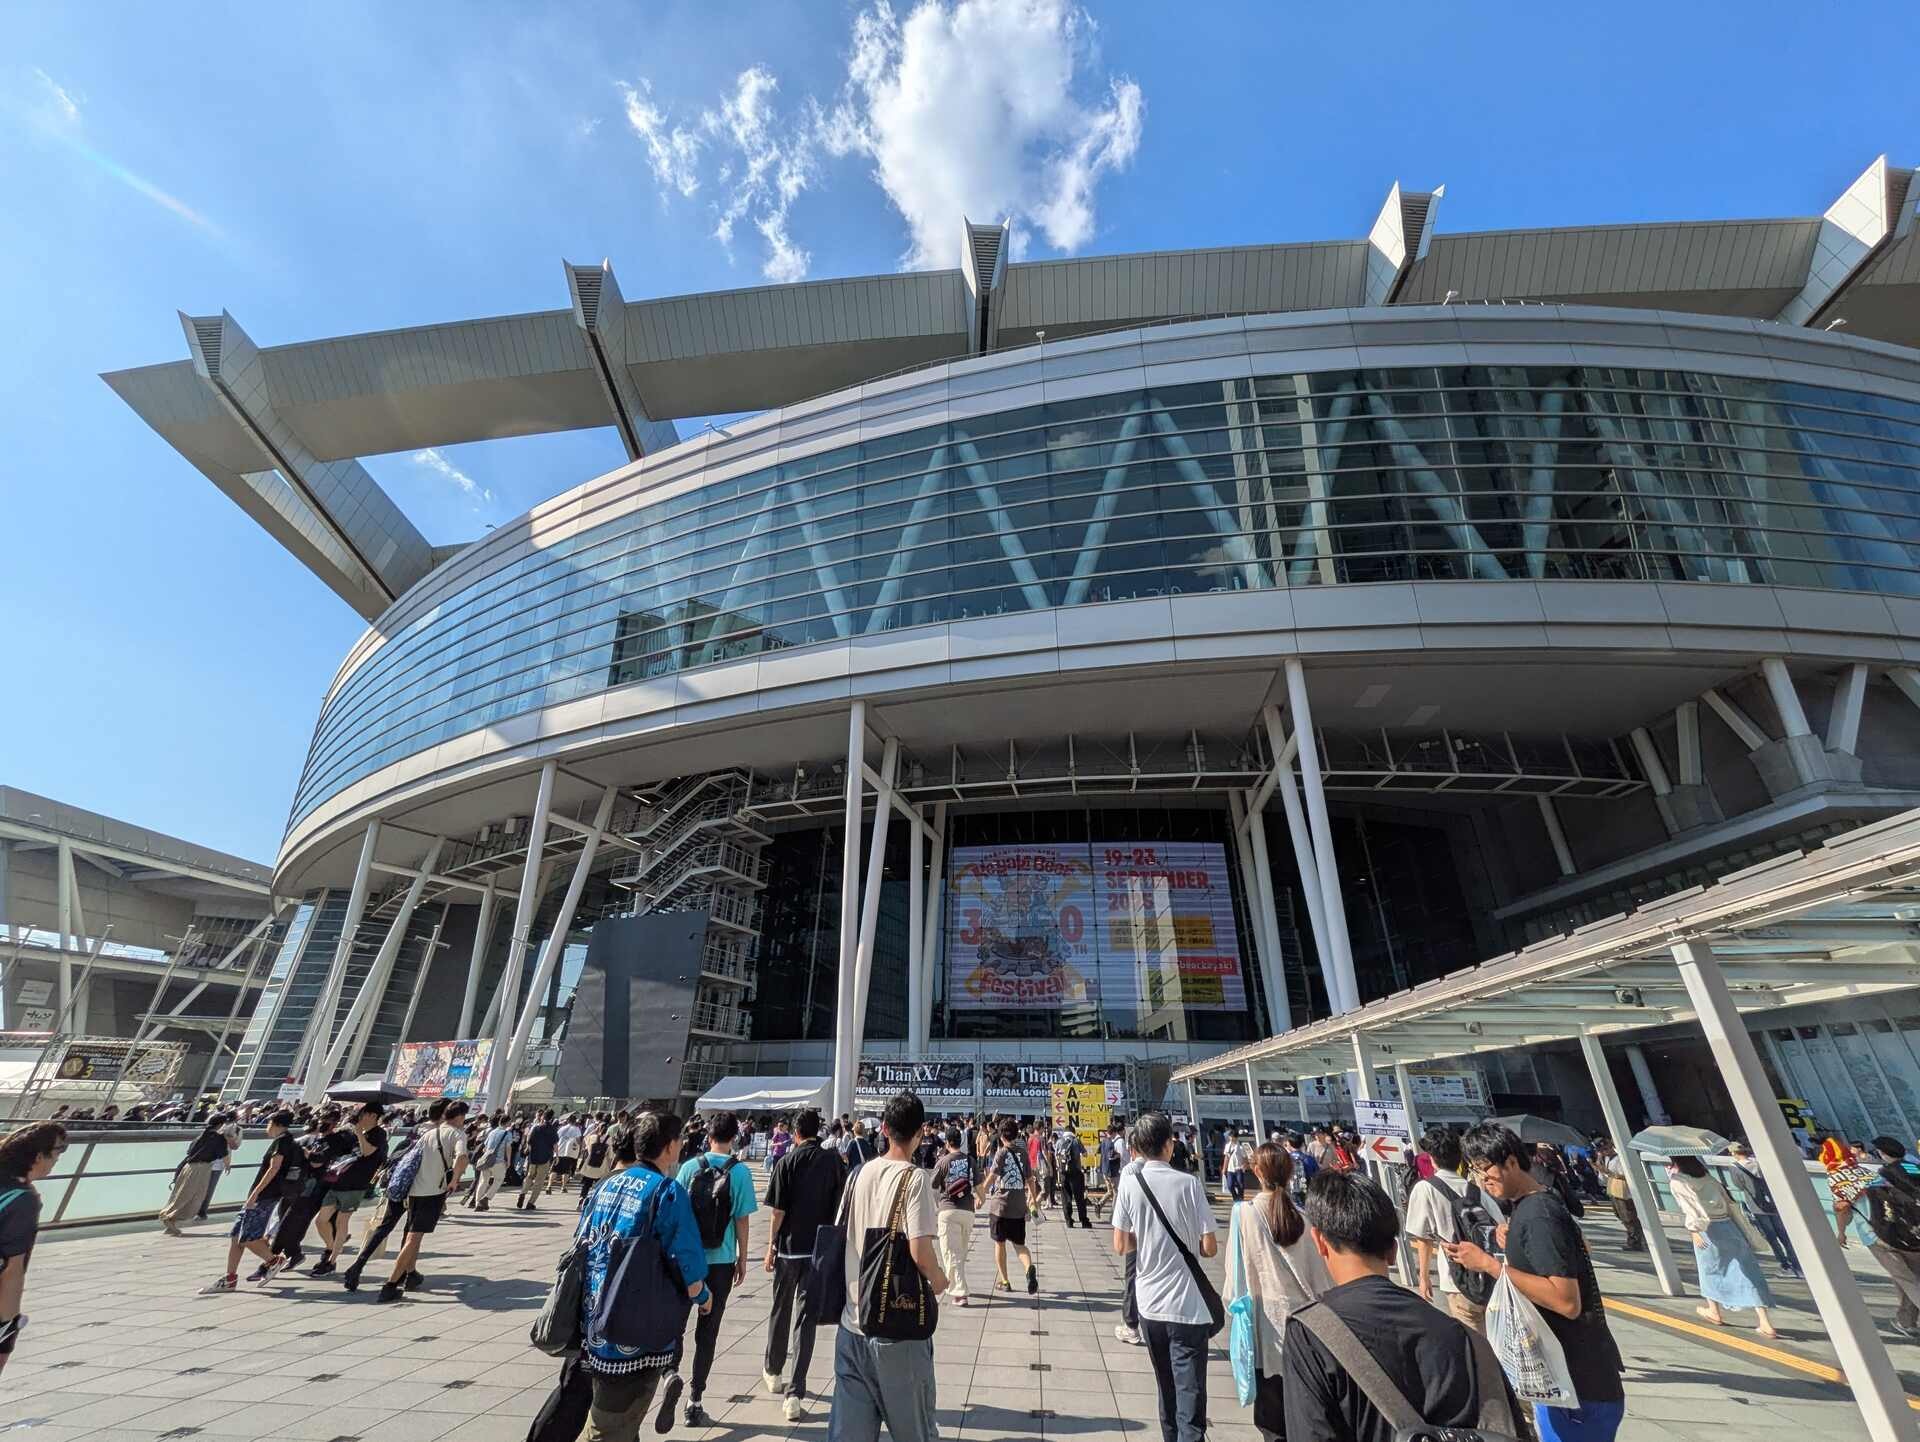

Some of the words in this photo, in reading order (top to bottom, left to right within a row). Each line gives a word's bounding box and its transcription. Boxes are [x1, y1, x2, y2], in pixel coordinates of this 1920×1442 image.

[1108, 892, 1154, 911] 205
[875, 1064, 941, 1082] ThanXX!
[1017, 1065, 1089, 1083] ThanXX!
[855, 1087, 878, 1096] FICIAL
[916, 1087, 941, 1096] ARTIST
[943, 1087, 971, 1096] GOODS
[986, 1087, 1021, 1097] OFFICIAL
[1067, 1087, 1078, 1099] A
[1066, 1101, 1080, 1113] W
[1068, 1115, 1080, 1127] N
